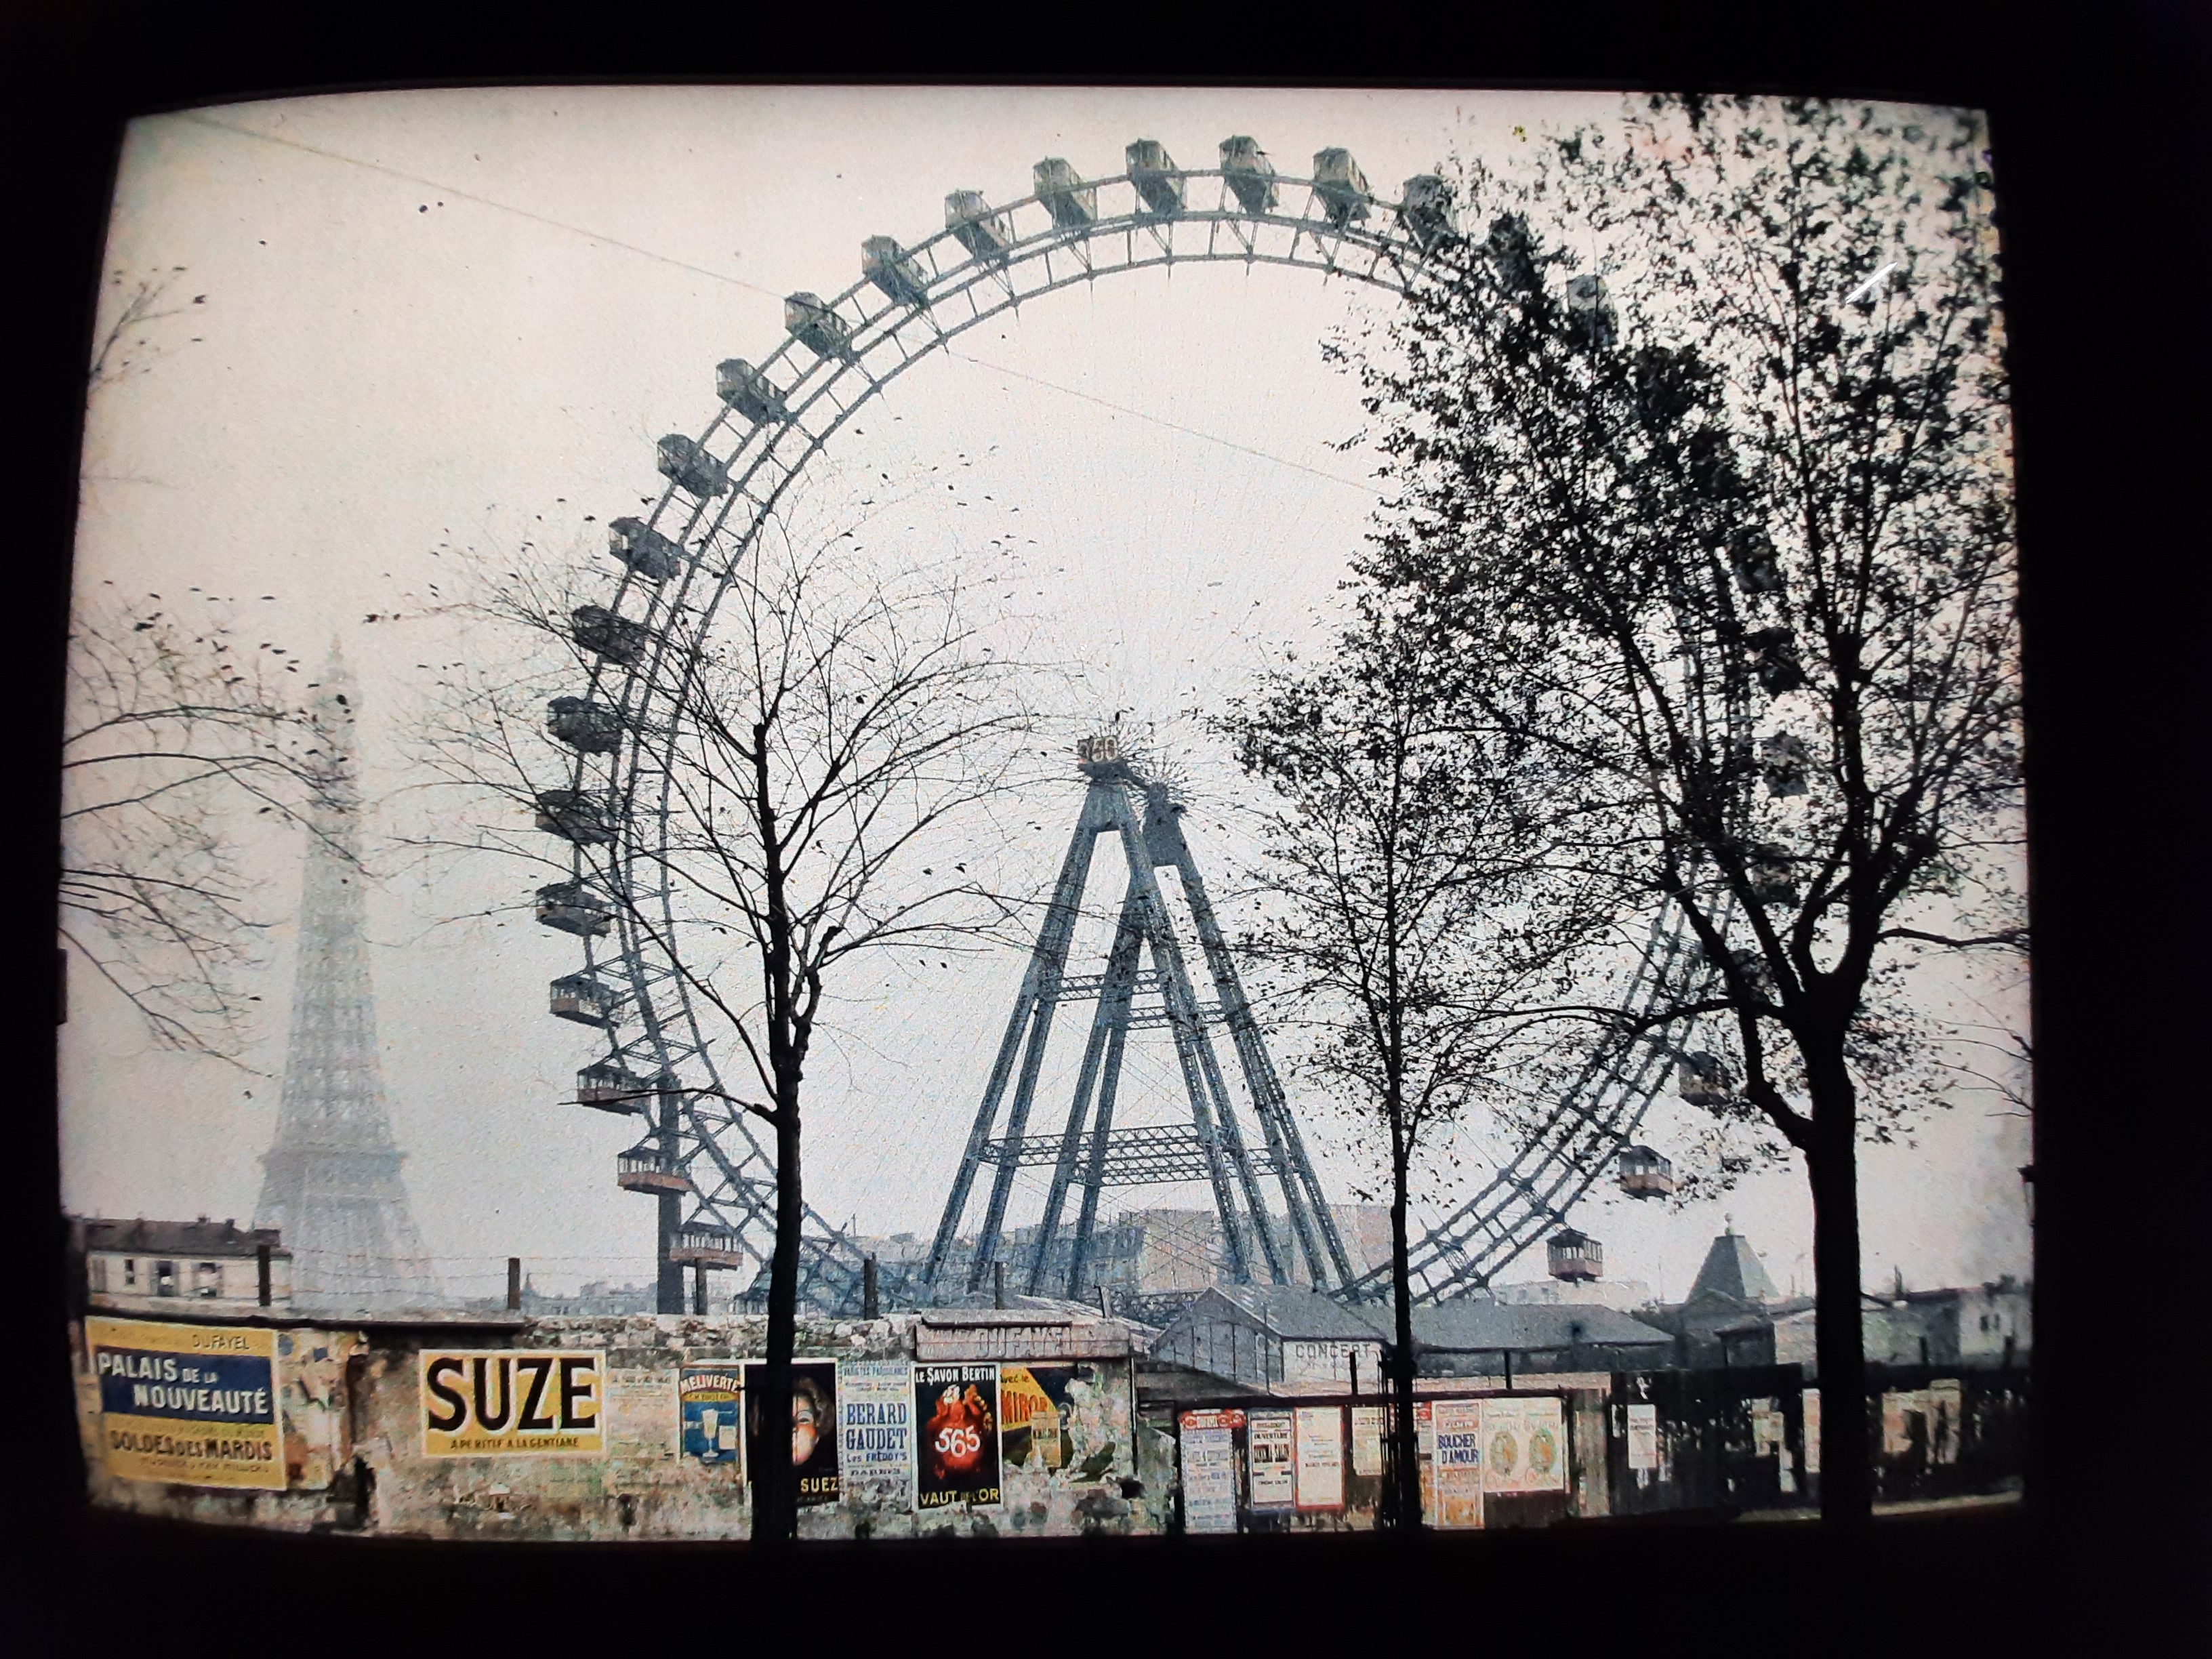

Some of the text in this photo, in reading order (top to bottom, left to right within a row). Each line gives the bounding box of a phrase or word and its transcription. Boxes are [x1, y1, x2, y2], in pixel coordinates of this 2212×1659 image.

[1295, 1343, 1370, 1359] CONCERT
[97, 1352, 219, 1385] PALAIS DE LA
[915, 1371, 926, 1383] LE
[926, 1366, 960, 1386] SAVON
[962, 1366, 996, 1382] BERTIN
[133, 1384, 270, 1415] NOUVEAUTÉ
[426, 1357, 596, 1432] SUZE
[205, 1437, 272, 1461] MARDIS
[846, 1427, 907, 1450] GAUDET
[935, 1425, 981, 1458] 565
[800, 1477, 839, 1493] SUEZ
[920, 1490, 957, 1505] VAUT
